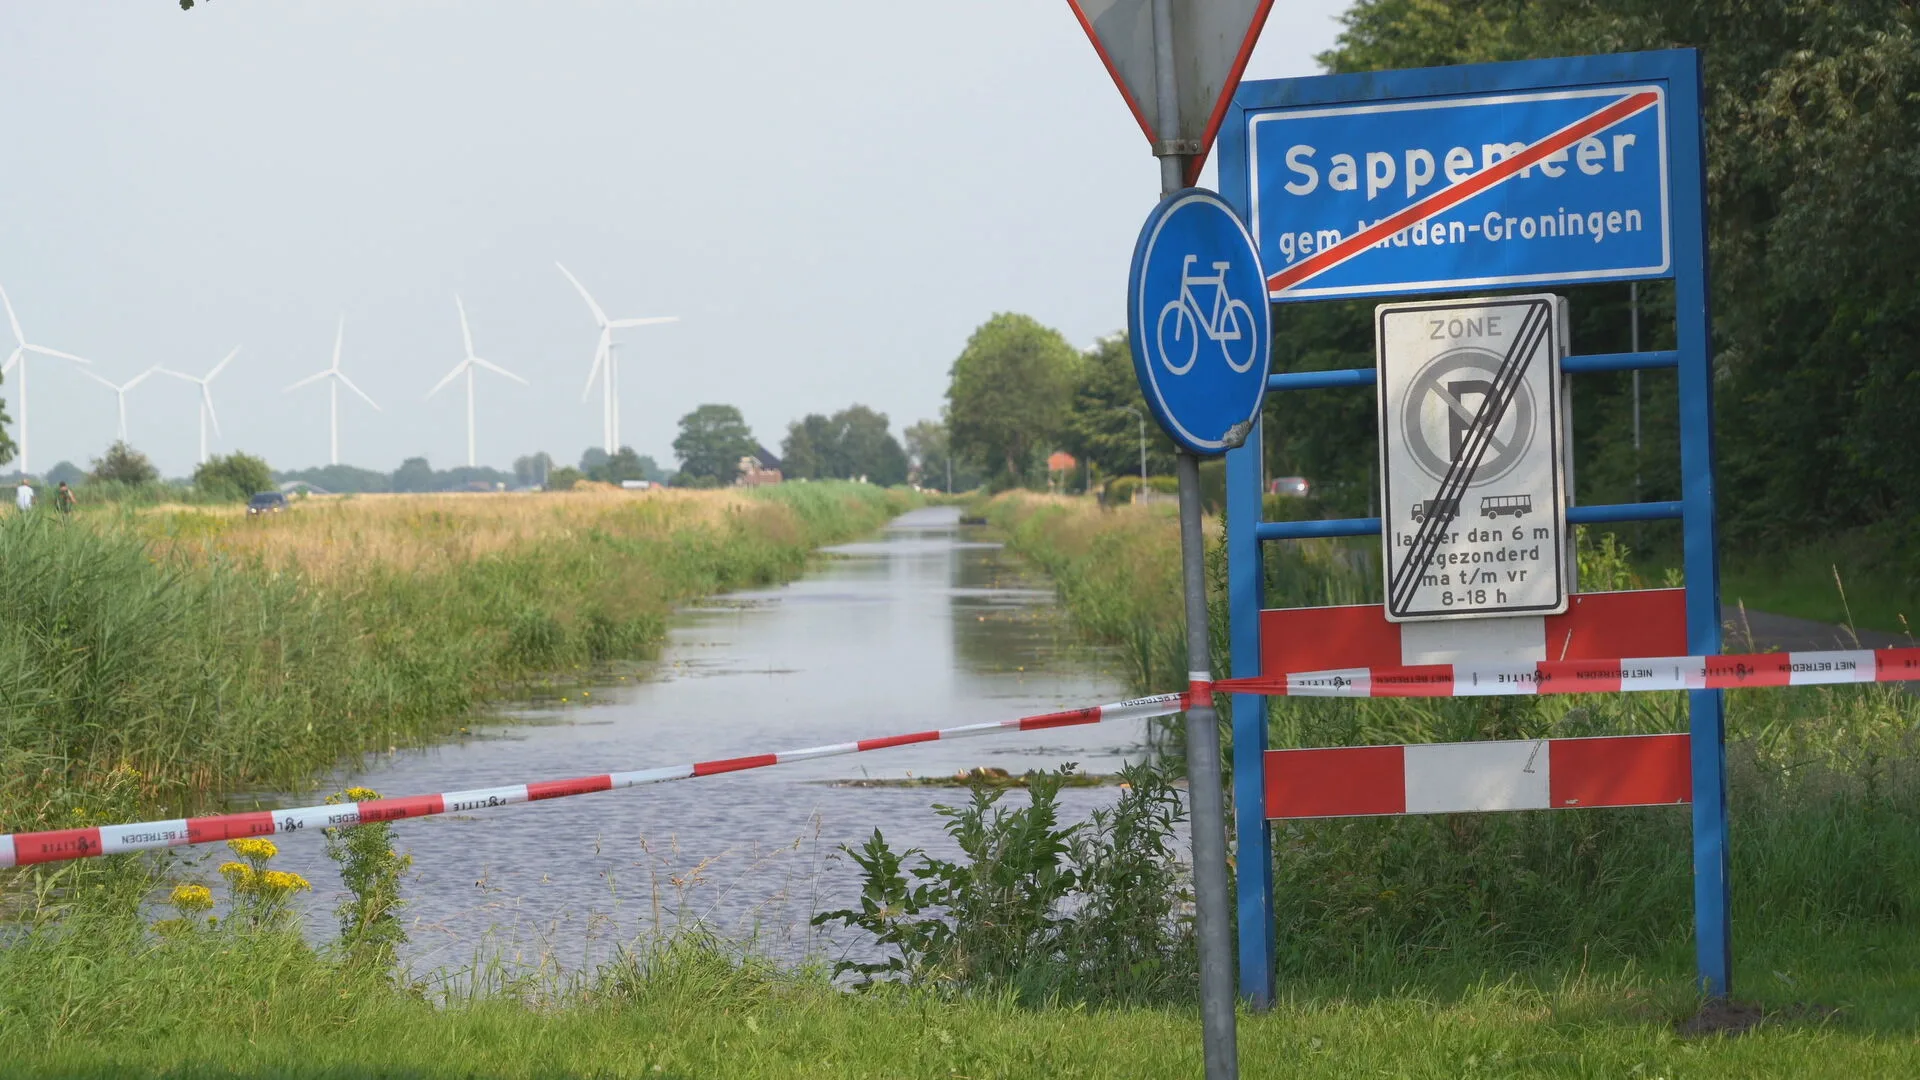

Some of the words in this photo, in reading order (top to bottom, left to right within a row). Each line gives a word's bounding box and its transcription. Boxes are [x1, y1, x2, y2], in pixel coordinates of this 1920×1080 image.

[1284, 134, 1636, 202] Sappemeer
[1358, 207, 1642, 249] dden-Groningen
[1429, 316, 1502, 340] ZONE
[1447, 380, 1503, 461] P
[1467, 528, 1503, 543] dan
[1512, 525, 1524, 541] 6
[1533, 526, 1550, 540] m
[1422, 573, 1450, 587] ma
[1459, 567, 1497, 585] t/m
[1507, 570, 1528, 582] vr
[1441, 590, 1487, 606] 8-18
[1496, 588, 1507, 604] h
[1631, 668, 1653, 679] NIET
[1778, 662, 1832, 672] BETREDEN
[1834, 661, 1856, 671] NIET
[121, 832, 176, 845] BETREDEN
